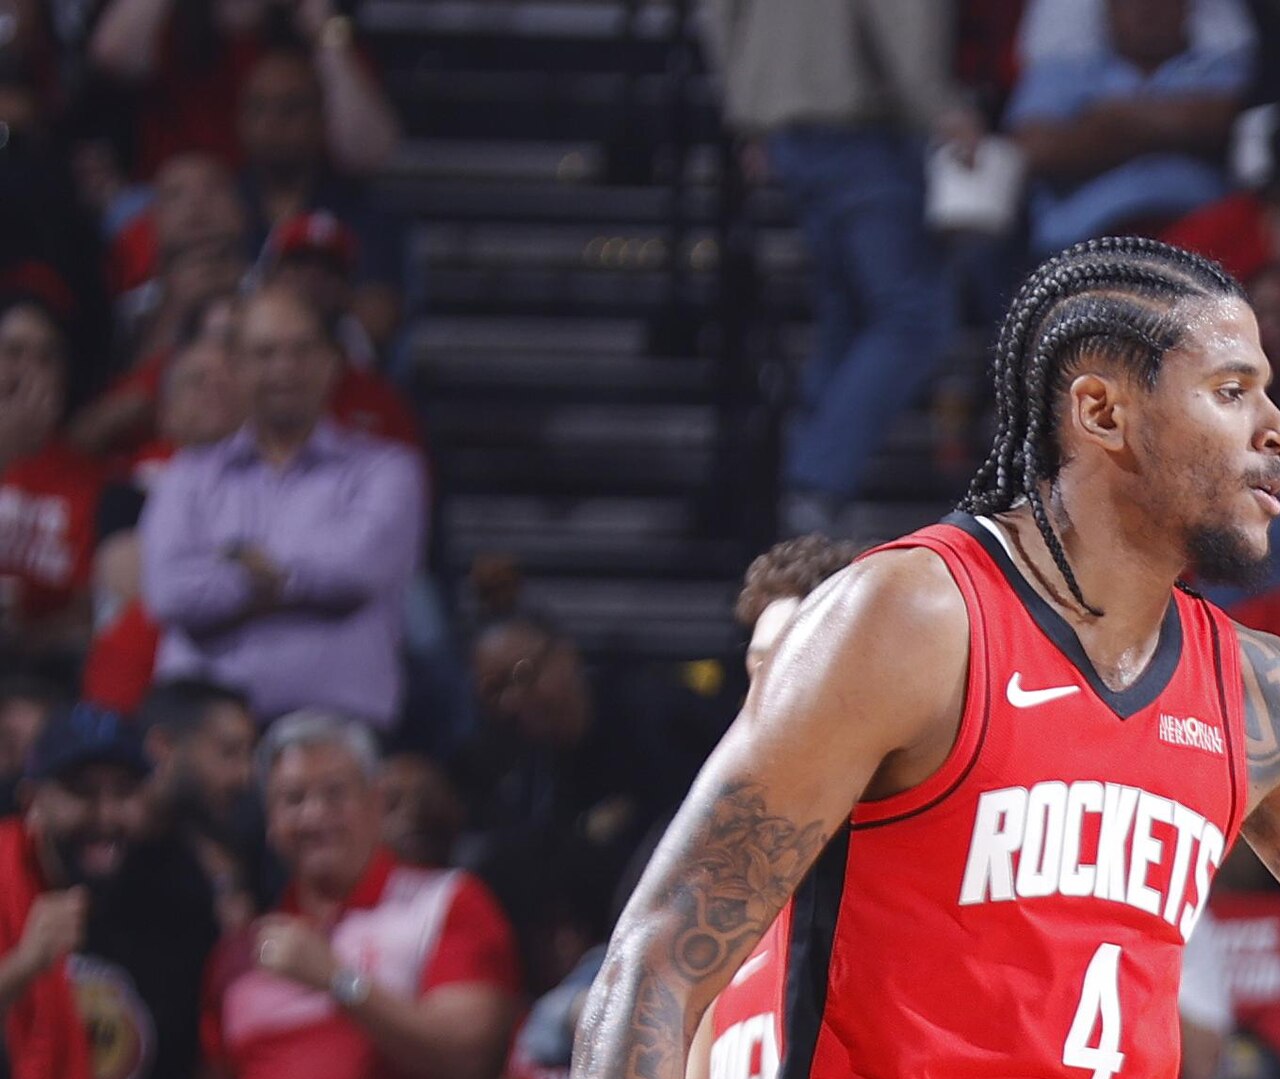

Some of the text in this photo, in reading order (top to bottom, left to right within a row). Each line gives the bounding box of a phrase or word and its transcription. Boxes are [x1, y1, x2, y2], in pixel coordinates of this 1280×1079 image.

[1160, 713, 1221, 741] MEMORIAL
[1160, 724, 1224, 754] HERMANN
[958, 780, 1226, 944] ROCKETS
